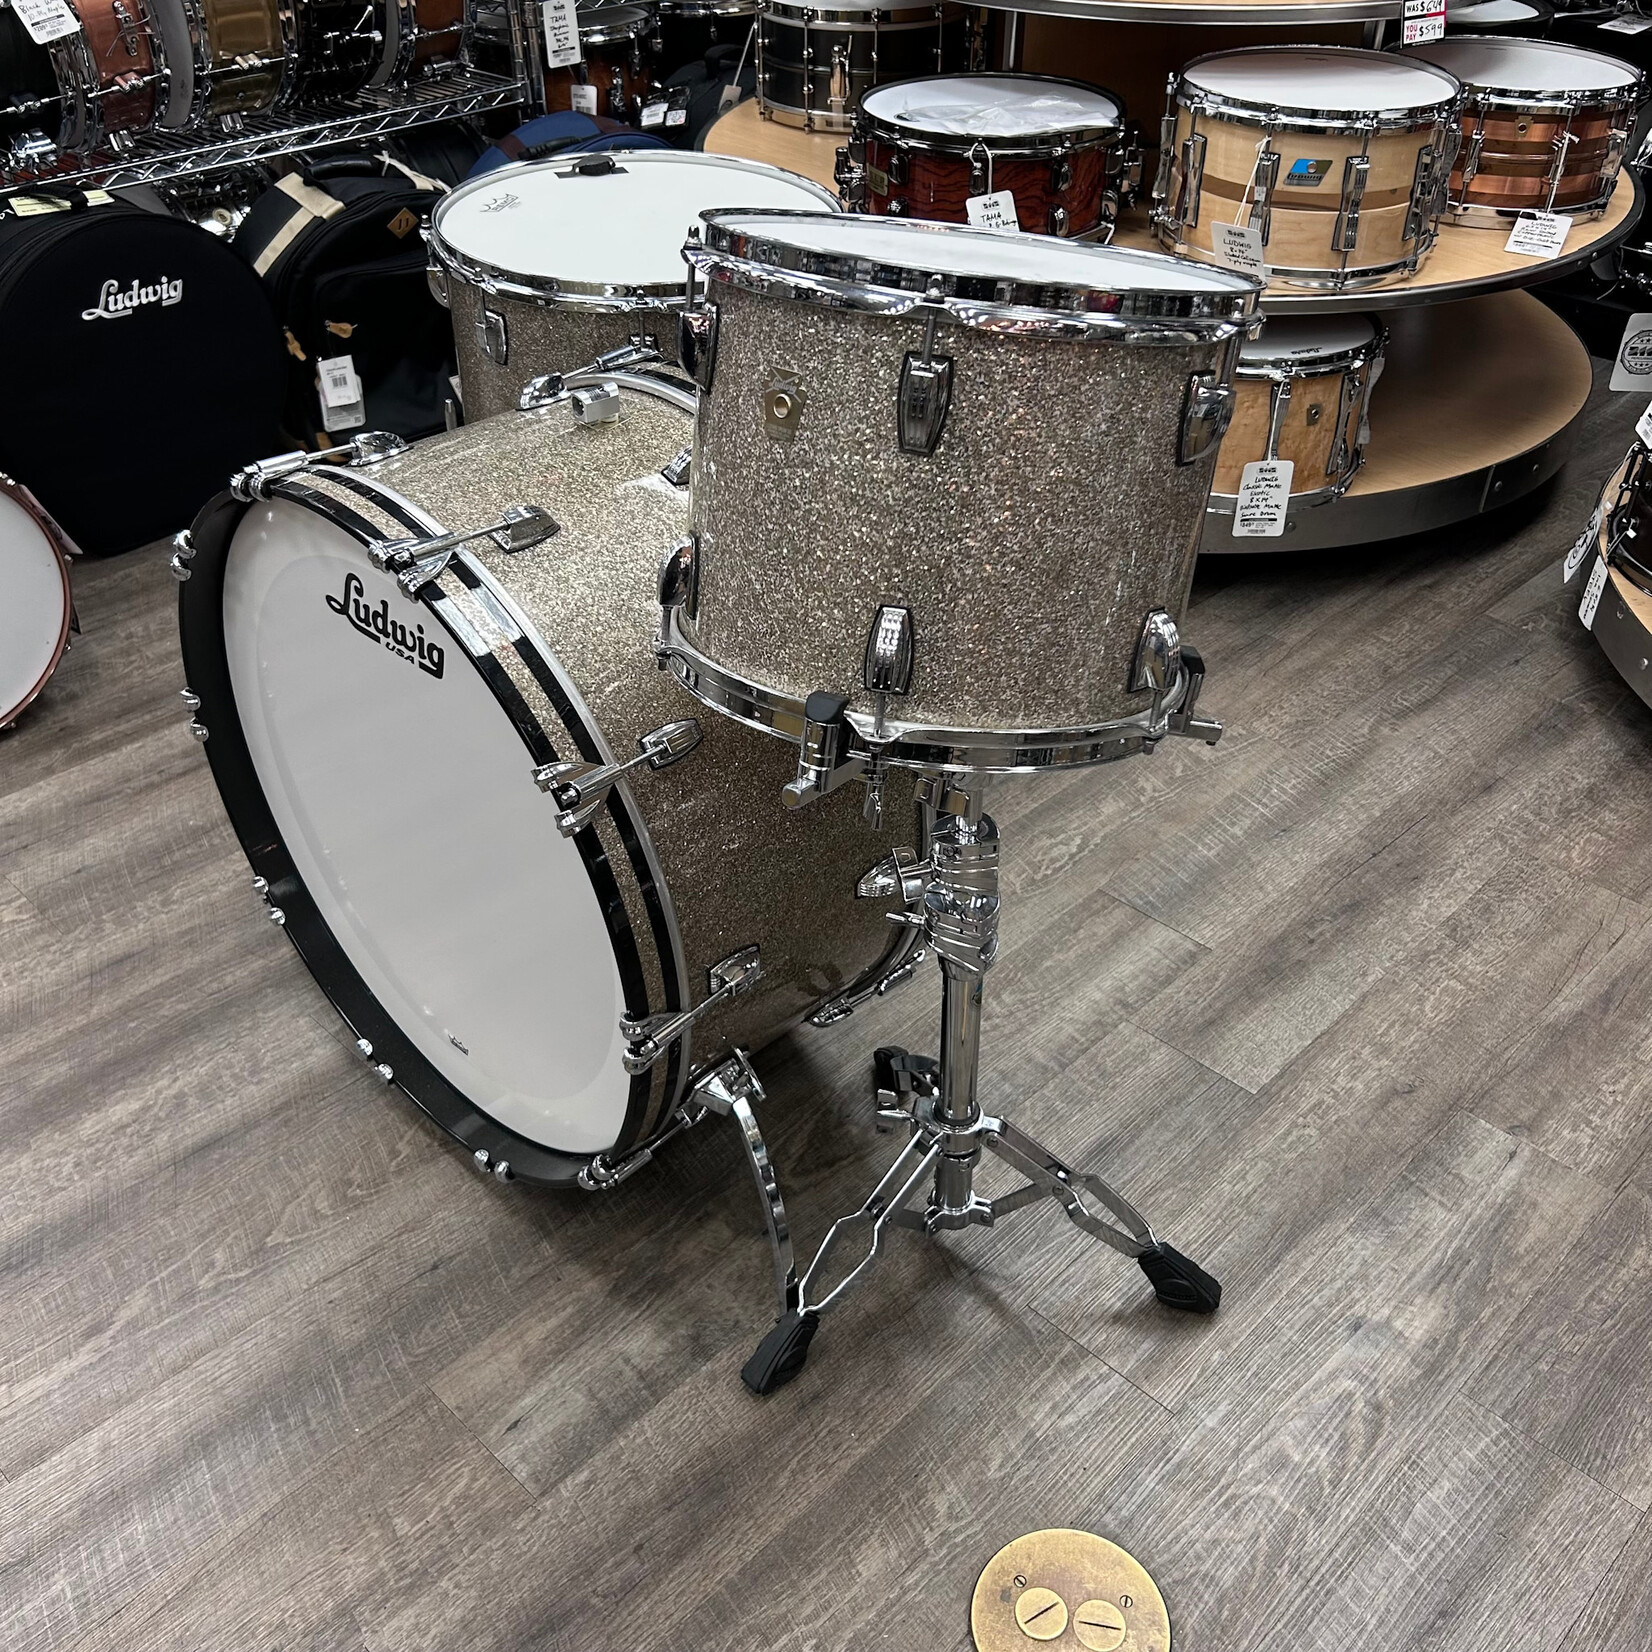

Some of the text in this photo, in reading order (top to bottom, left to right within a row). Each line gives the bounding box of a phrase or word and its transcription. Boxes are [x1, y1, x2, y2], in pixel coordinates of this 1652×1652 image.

[1406, 4, 1419, 13] WAS
[1405, 24, 1418, 33] YOU
[1405, 33, 1417, 42] PAY
[980, 212, 1002, 223] TAMA
[1223, 238, 1252, 249] LUDWIG
[82, 275, 184, 321] Ludwig
[325, 572, 445, 680] Ludwig
[385, 641, 415, 665] USA
